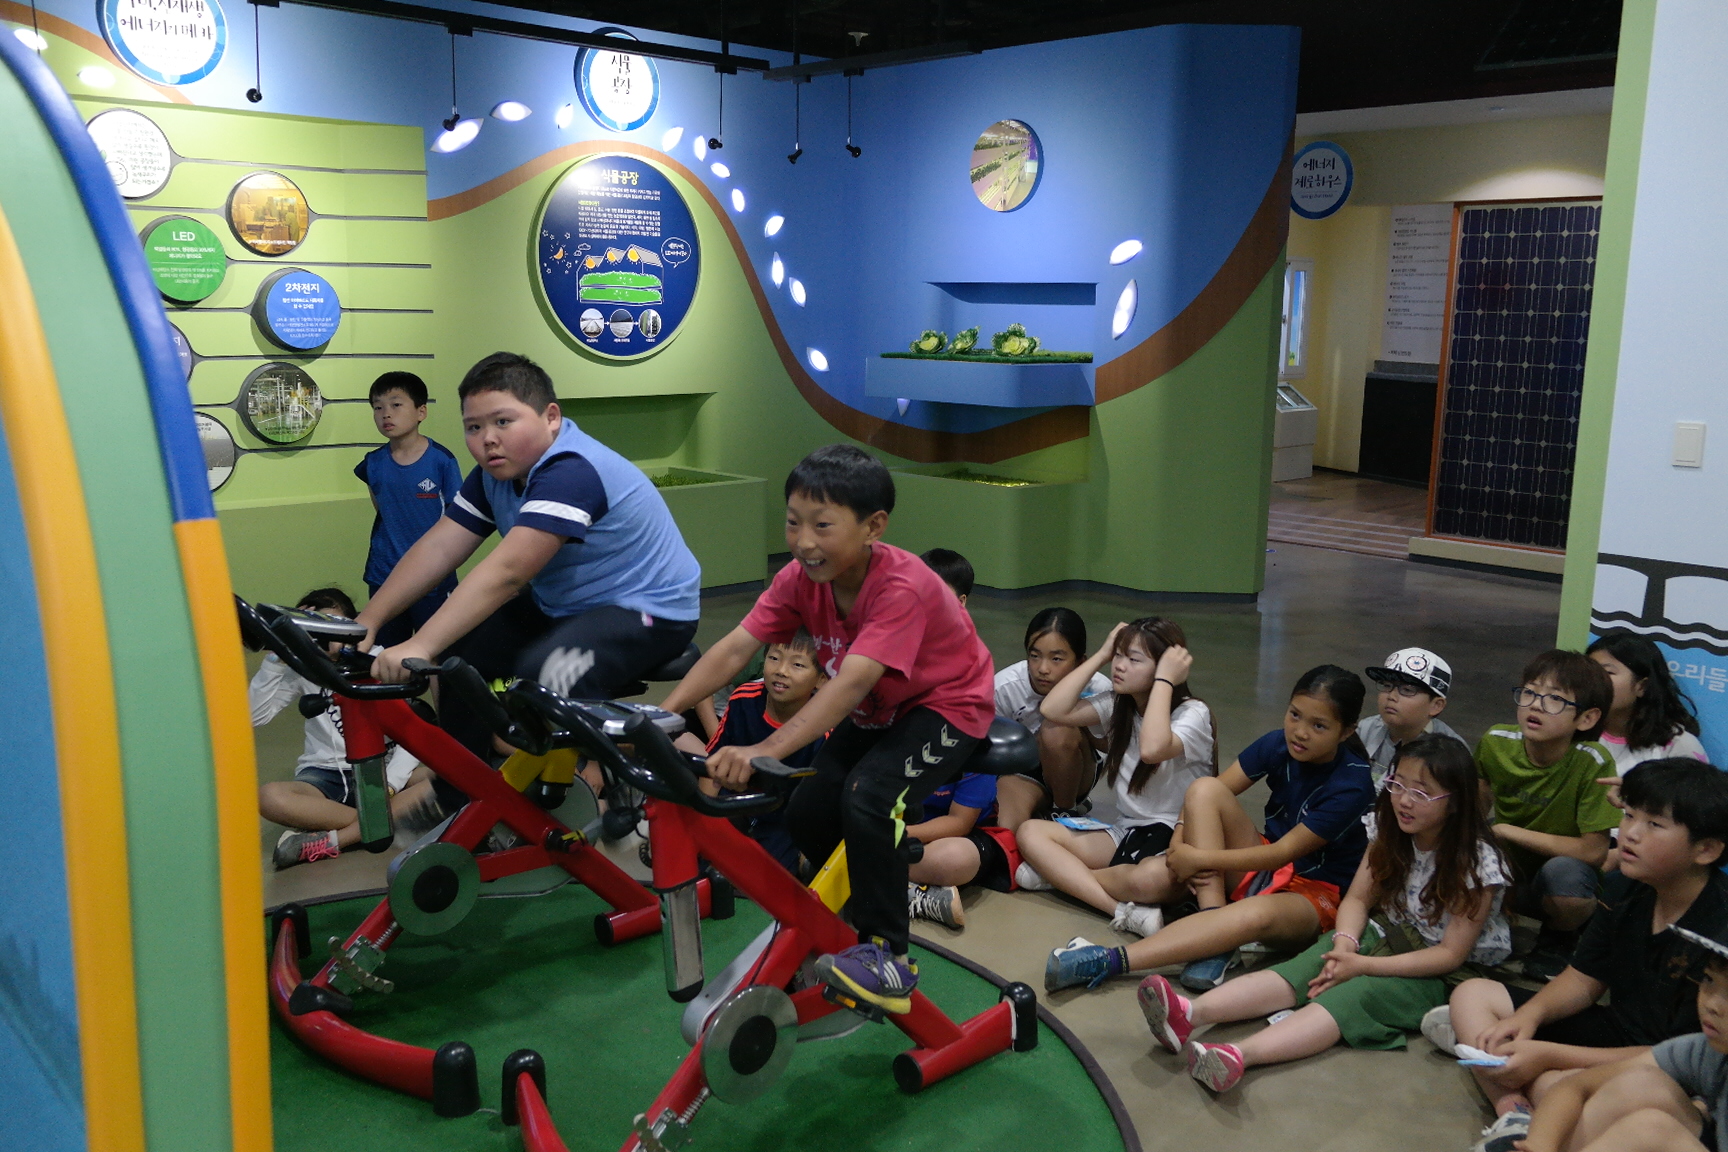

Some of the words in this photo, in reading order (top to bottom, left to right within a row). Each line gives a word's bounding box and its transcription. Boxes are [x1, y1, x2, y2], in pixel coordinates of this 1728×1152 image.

[611, 53, 632, 75] 식물
[1302, 157, 1336, 171] 에너지
[601, 168, 639, 185] 식물공장
[1294, 173, 1342, 189] 제로하우스
[172, 231, 196, 241] LED
[285, 282, 320, 295] 2차전지
